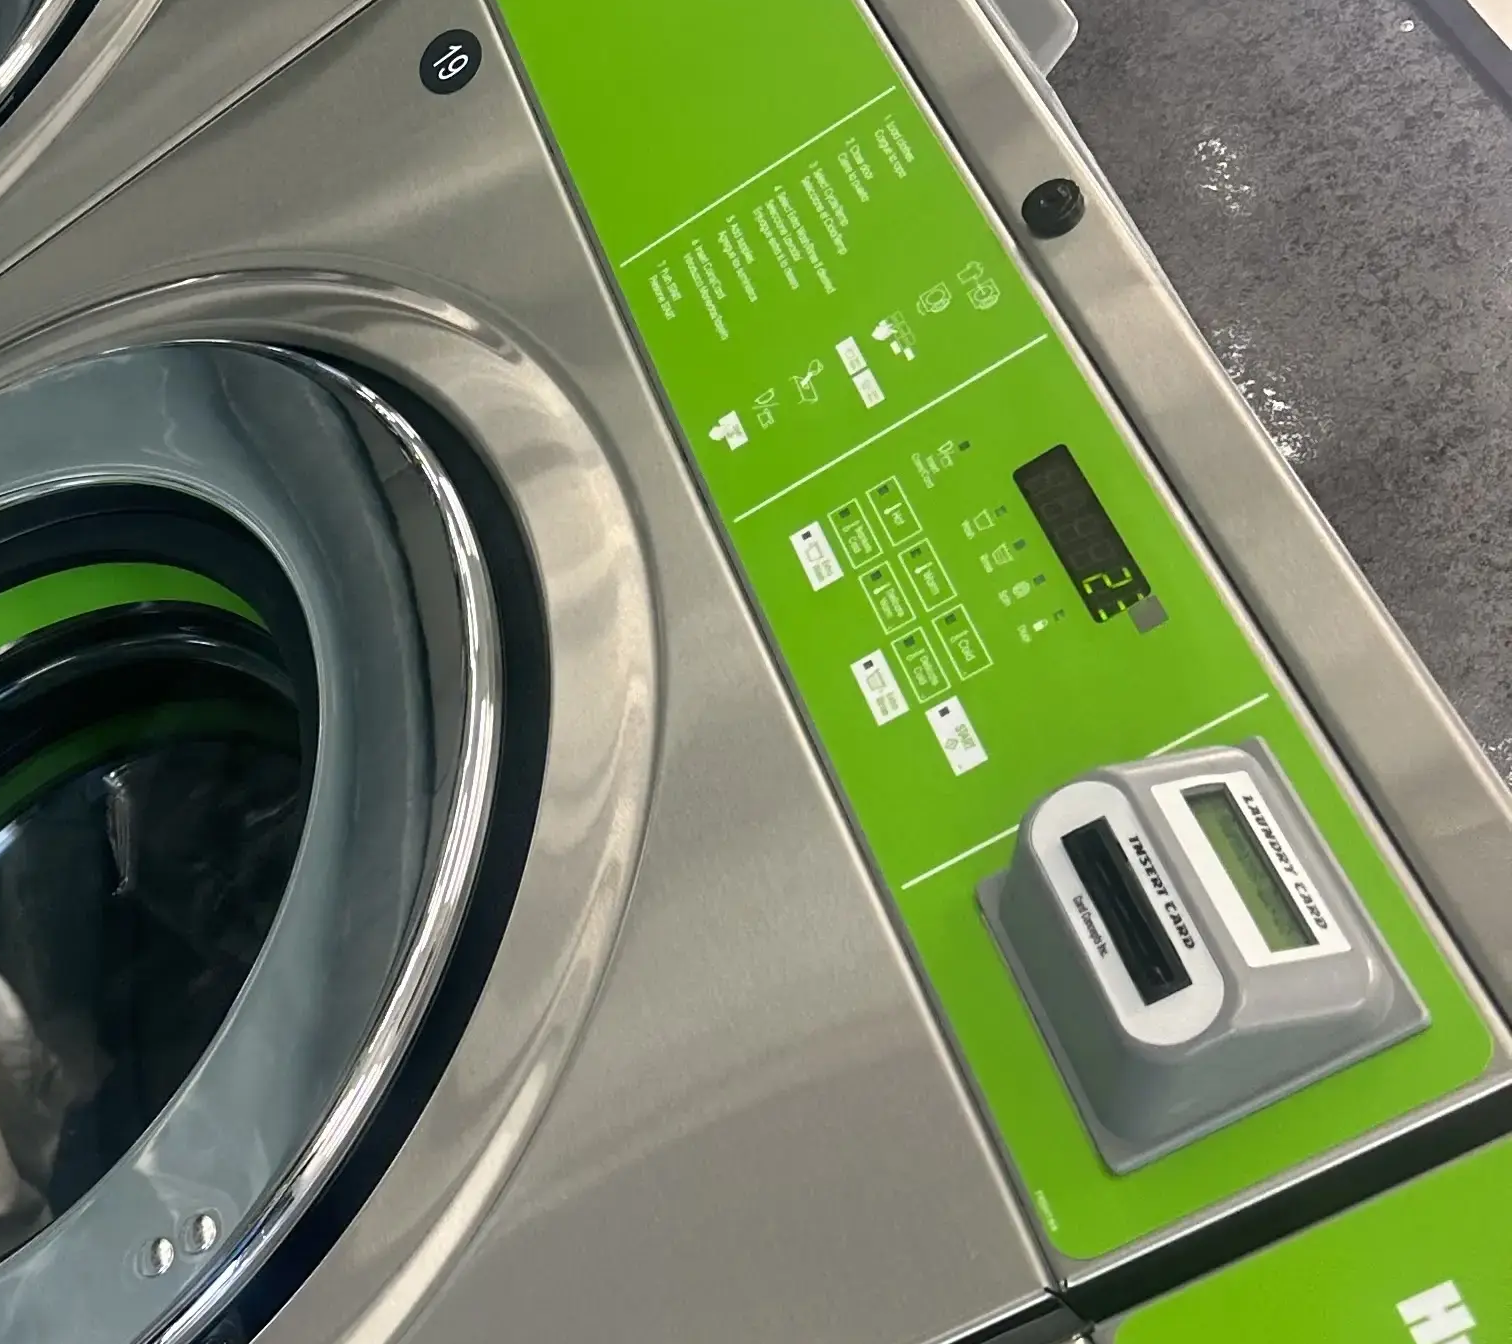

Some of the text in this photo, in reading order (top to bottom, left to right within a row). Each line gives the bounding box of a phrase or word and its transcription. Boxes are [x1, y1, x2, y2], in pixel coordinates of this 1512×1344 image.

[433, 45, 468, 79] 19
[958, 639, 976, 661] Cold
[1129, 836, 1195, 949] INSERT CARD
[1242, 796, 1327, 929] LAUNDRY CARD
